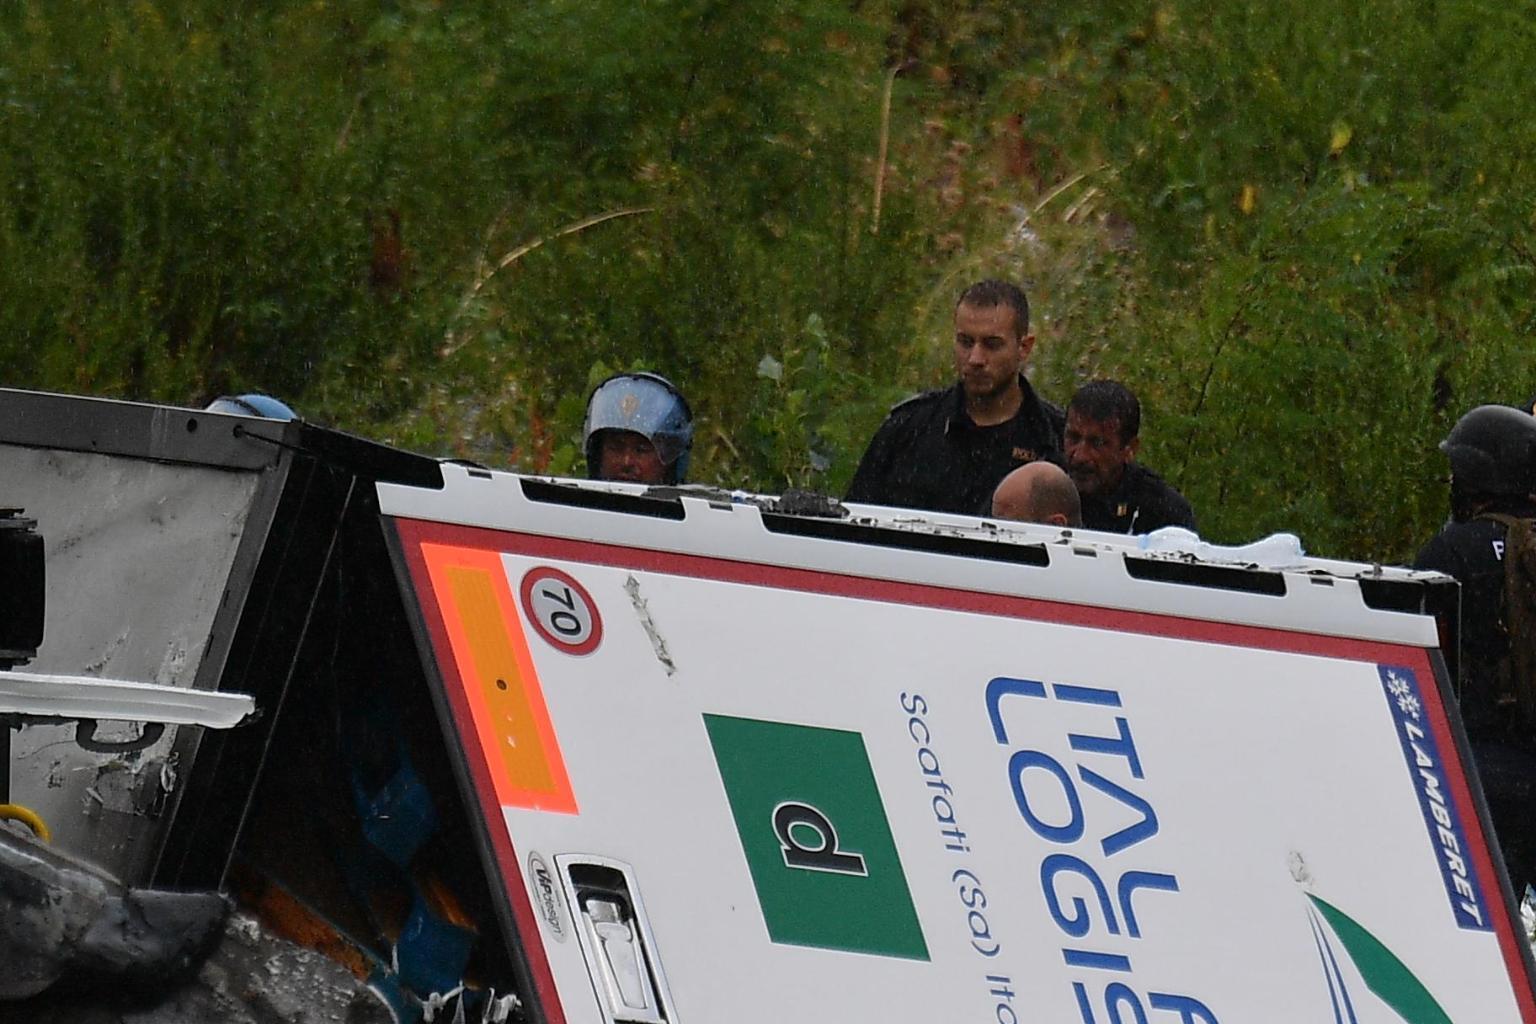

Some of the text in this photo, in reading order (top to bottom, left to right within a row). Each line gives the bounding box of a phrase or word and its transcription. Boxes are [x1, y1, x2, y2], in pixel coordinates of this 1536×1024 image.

[541, 587, 582, 636] 70
[771, 801, 869, 877] d
[899, 691, 971, 853] Scafati
[951, 868, 1001, 958] (Sa)
[1404, 721, 1484, 927] LAMBERET
